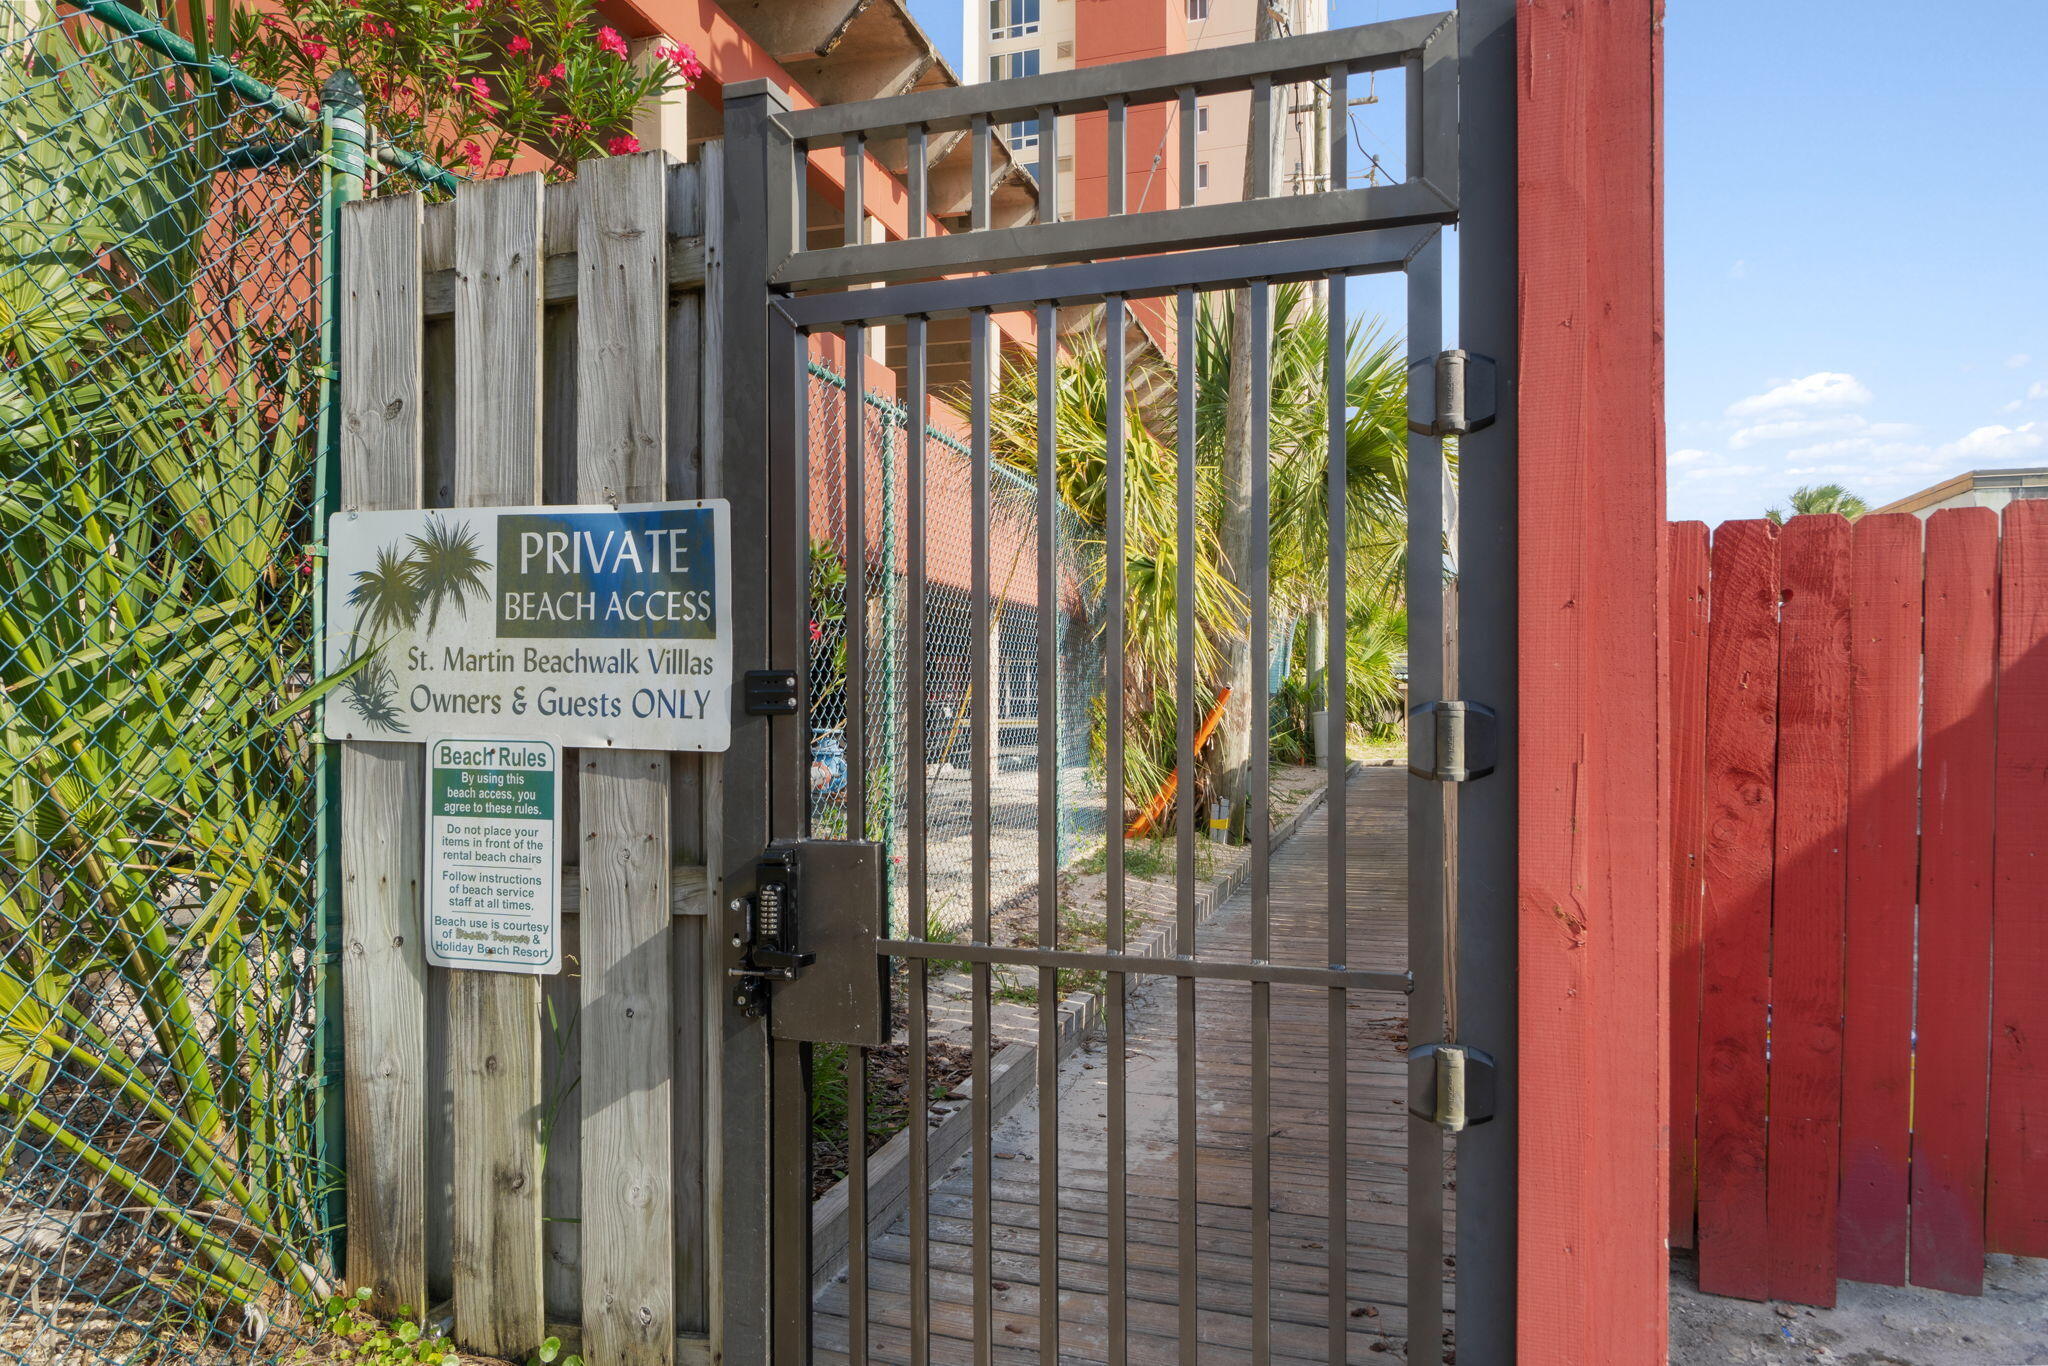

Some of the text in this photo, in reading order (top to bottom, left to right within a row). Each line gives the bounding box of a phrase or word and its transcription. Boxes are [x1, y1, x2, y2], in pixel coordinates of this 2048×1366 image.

[520, 528, 689, 575] PRIVATE
[505, 590, 711, 622] BEACH ACCESS
[408, 646, 434, 673] St.
[443, 646, 514, 673] Martin
[524, 647, 639, 674] Beachwalk
[410, 684, 710, 719] Owners & Guests ONLY
[440, 746, 547, 767] Beach Rules
[461, 772, 525, 785] By using this
[447, 787, 536, 802] beach access, you
[444, 802, 542, 815] agree to these rules.
[447, 824, 539, 838] Do not place your
[442, 836, 543, 849] items in front of the
[443, 851, 542, 864] rental beach chairs
[443, 871, 542, 885] Follow instructions
[449, 884, 534, 897] of beach service
[449, 897, 534, 910] staff at all times.
[434, 916, 549, 934] Beach use is courtesy
[443, 929, 452, 938] of
[533, 934, 540, 945] &
[435, 941, 549, 958] Holiday Beach Resort
